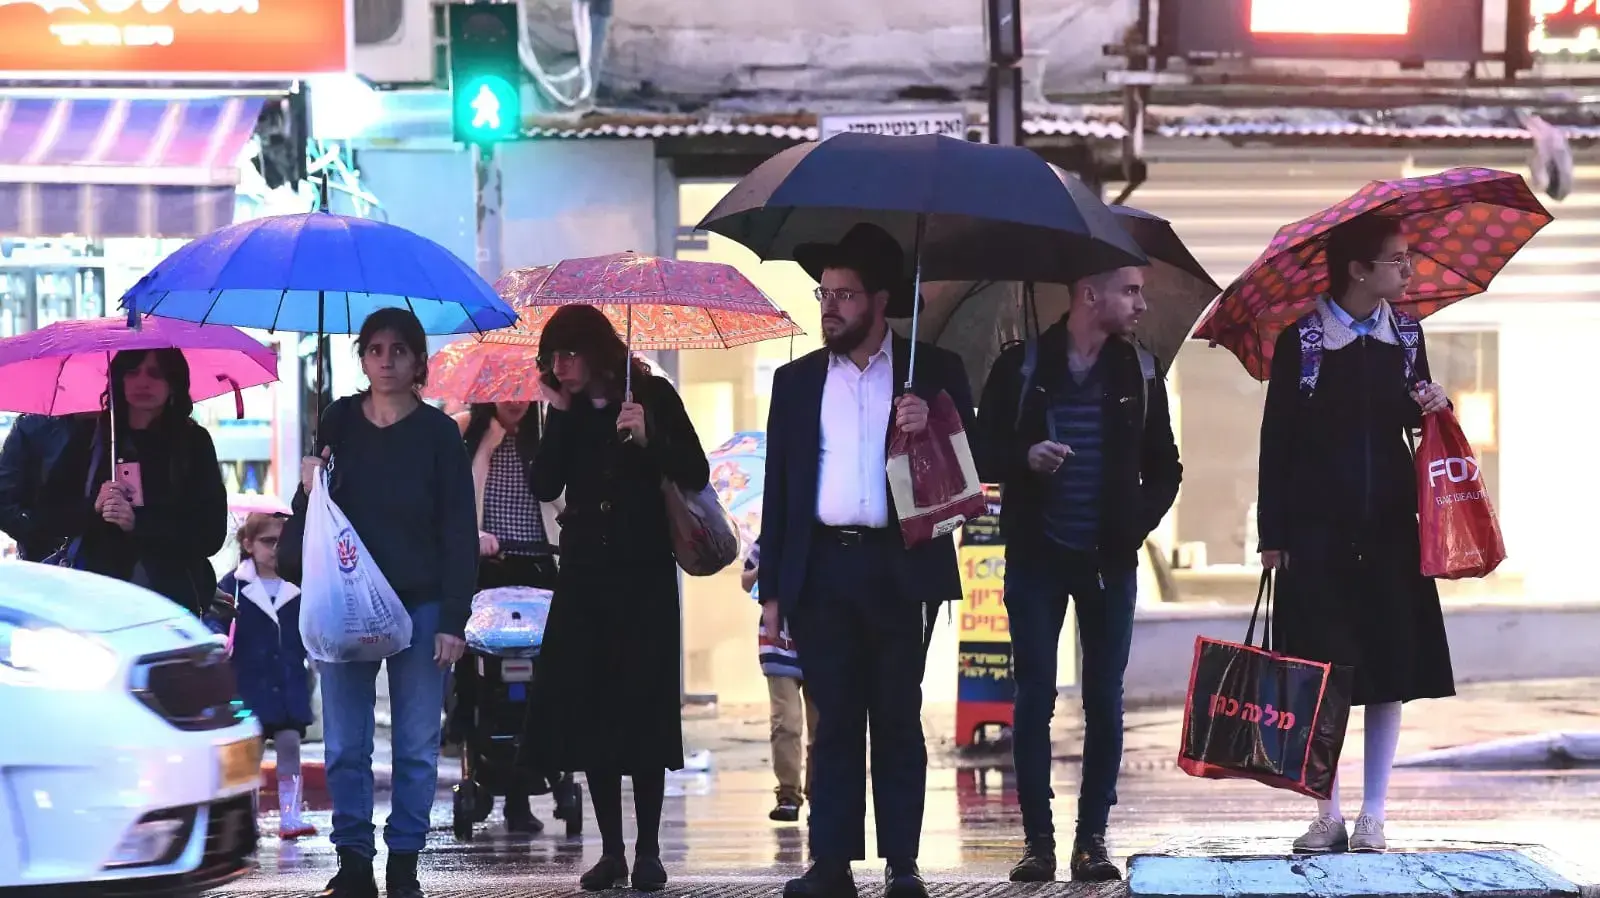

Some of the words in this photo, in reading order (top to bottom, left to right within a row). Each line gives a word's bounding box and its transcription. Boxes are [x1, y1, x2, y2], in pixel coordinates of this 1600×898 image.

[935, 119, 961, 134] זאב
[1428, 456, 1480, 488] FOX
[961, 613, 1009, 632] כויים
